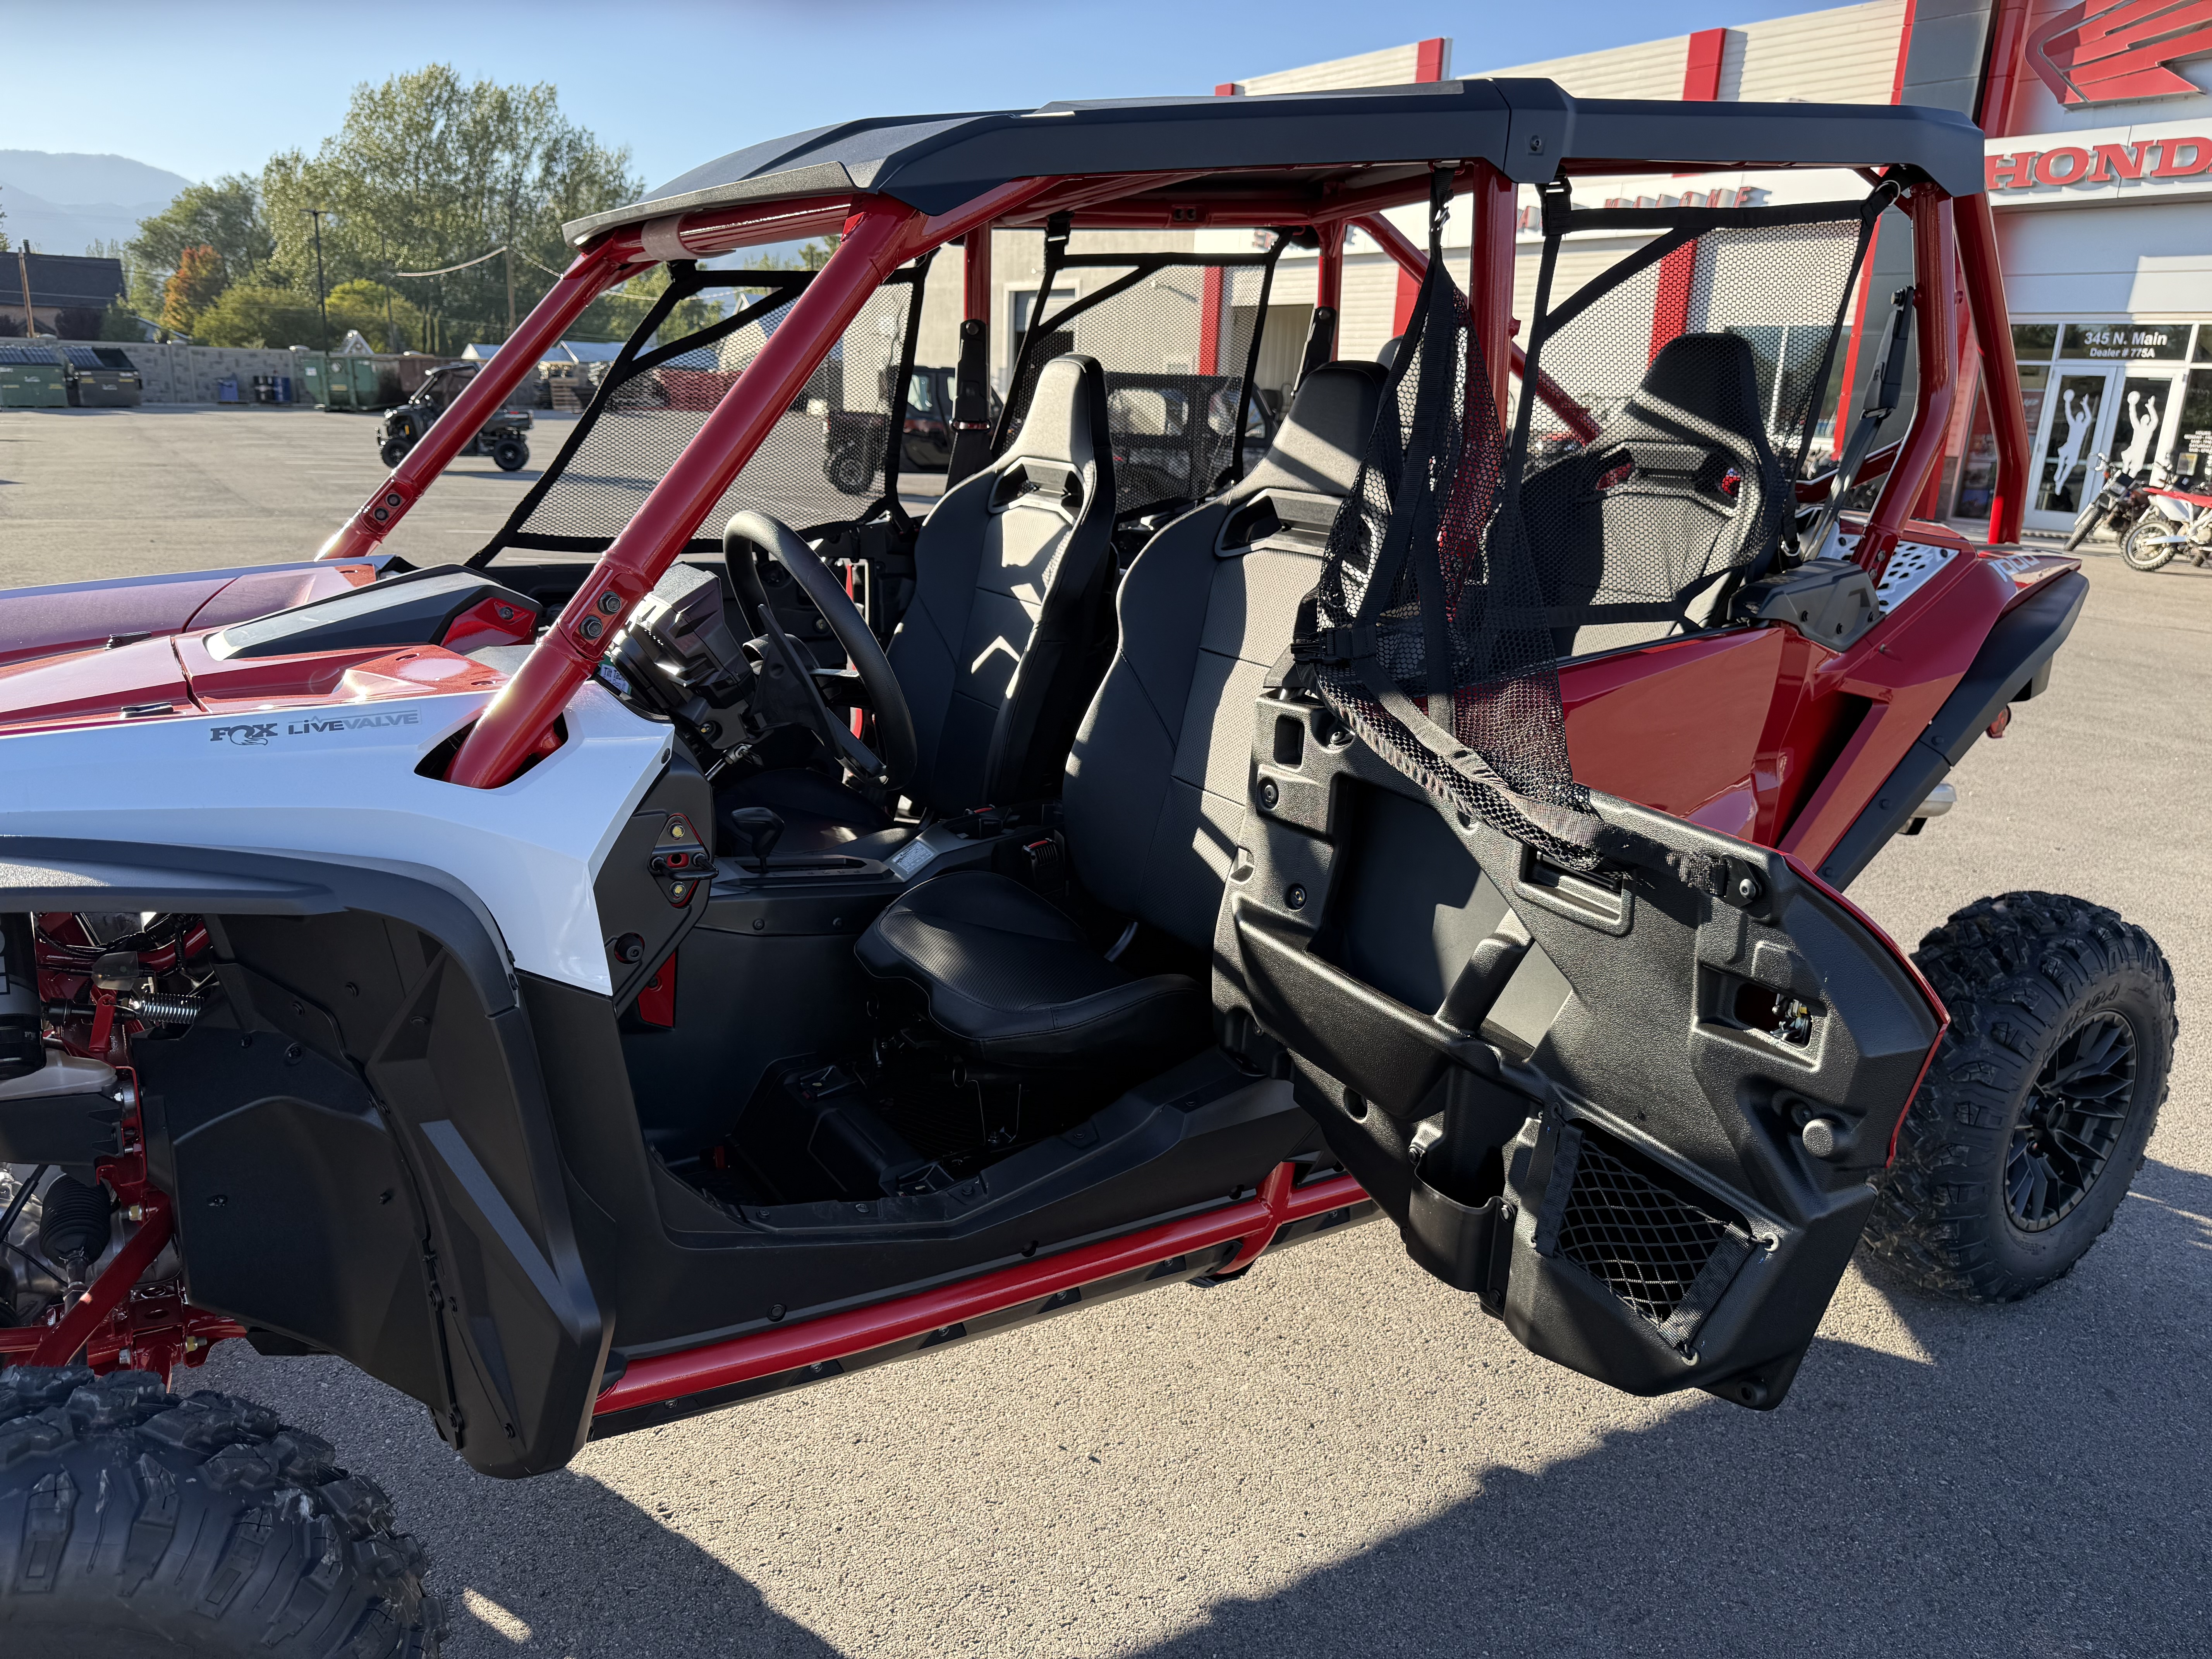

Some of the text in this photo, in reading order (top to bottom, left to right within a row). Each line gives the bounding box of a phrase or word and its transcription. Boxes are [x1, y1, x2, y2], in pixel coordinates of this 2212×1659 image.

[1985, 136, 2212, 190] HOND
[2084, 331, 2168, 345] 345 N. Main
[2090, 348, 2121, 357] Dealer
[2121, 348, 2130, 357] #
[1987, 555, 2040, 582] 1000
[604, 667, 612, 677] Tilt
[210, 723, 278, 746] FOX
